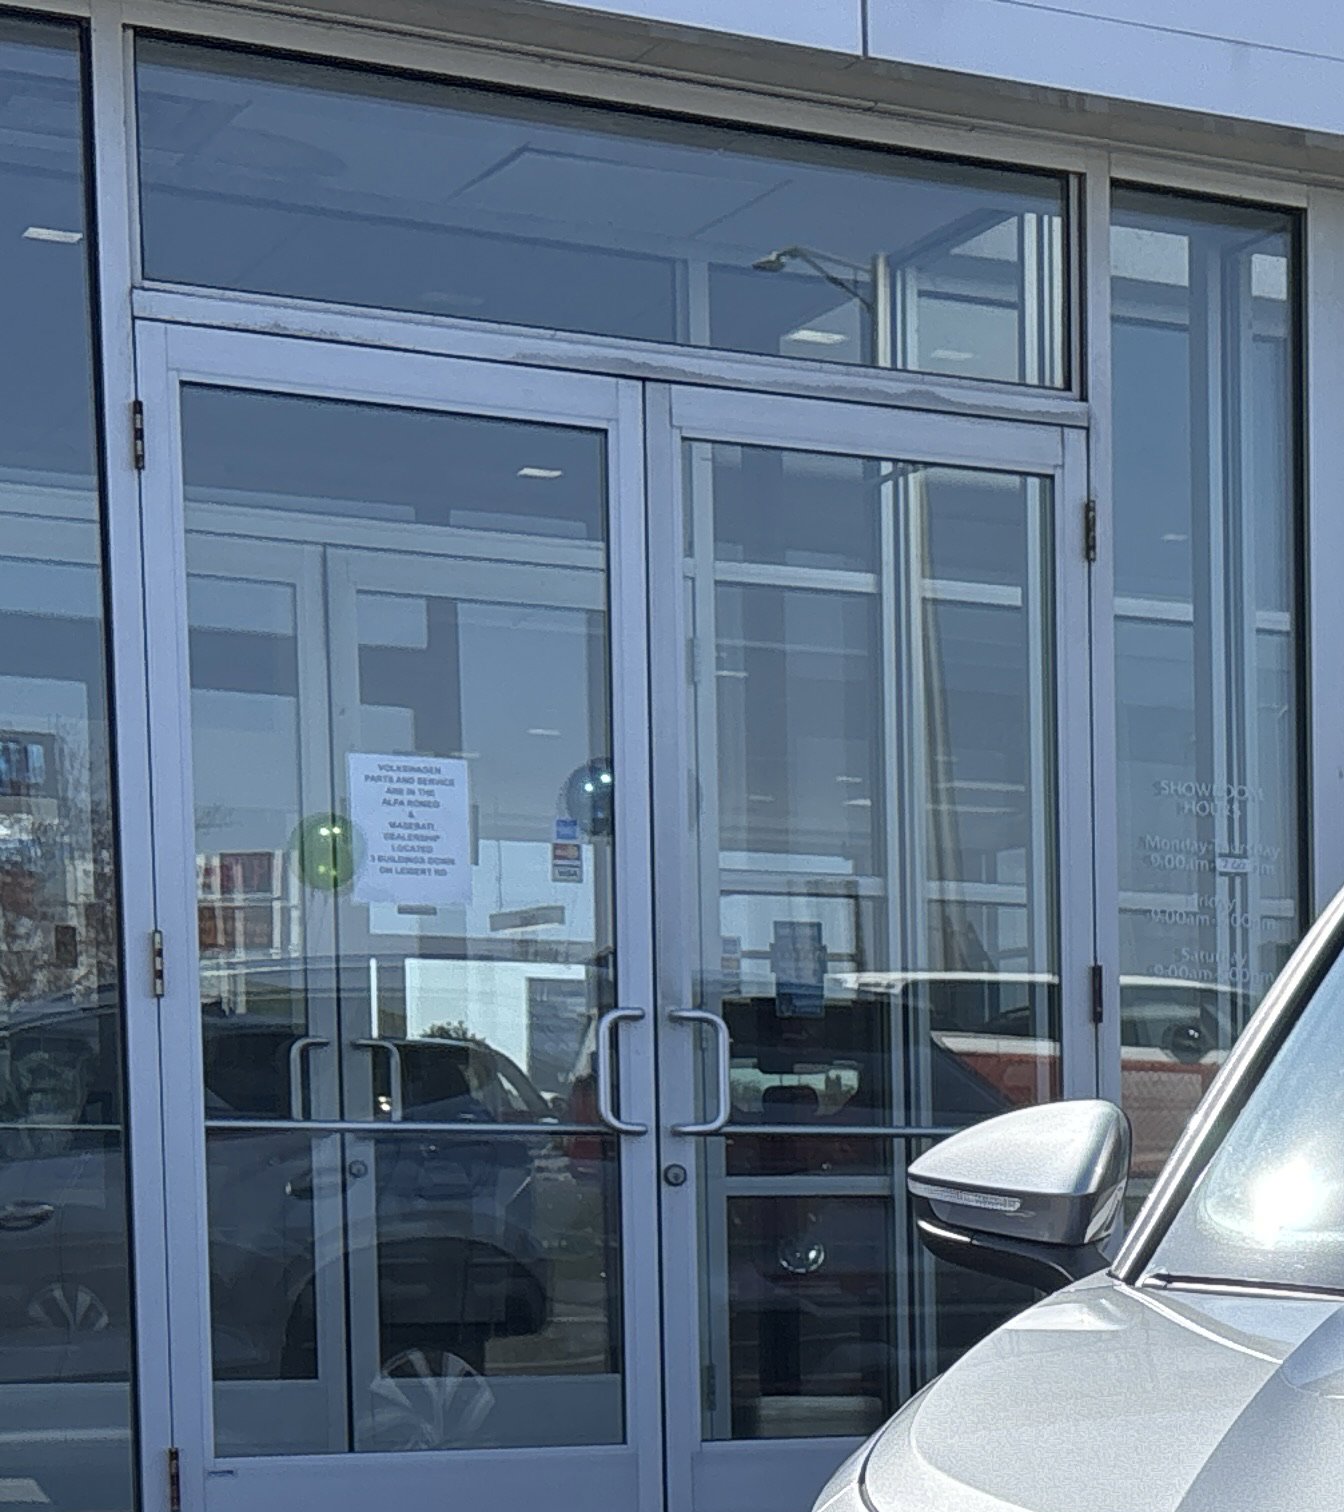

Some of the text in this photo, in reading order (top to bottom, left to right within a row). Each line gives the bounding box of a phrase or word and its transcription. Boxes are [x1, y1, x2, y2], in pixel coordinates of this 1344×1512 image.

[377, 764, 442, 774] VOLKSWAGEN
[364, 774, 455, 787] PARTS AND SERVICE
[385, 787, 435, 797] ARE IN THE
[1160, 779, 1263, 801] SHOWOOM
[382, 798, 440, 808] ALFA ROMEO
[388, 821, 435, 831] MASERATI
[383, 832, 440, 842] DEALERSHIP
[391, 844, 434, 853] LOCATED
[377, 855, 425, 864] BUILDINGS
[379, 866, 393, 874] ON
